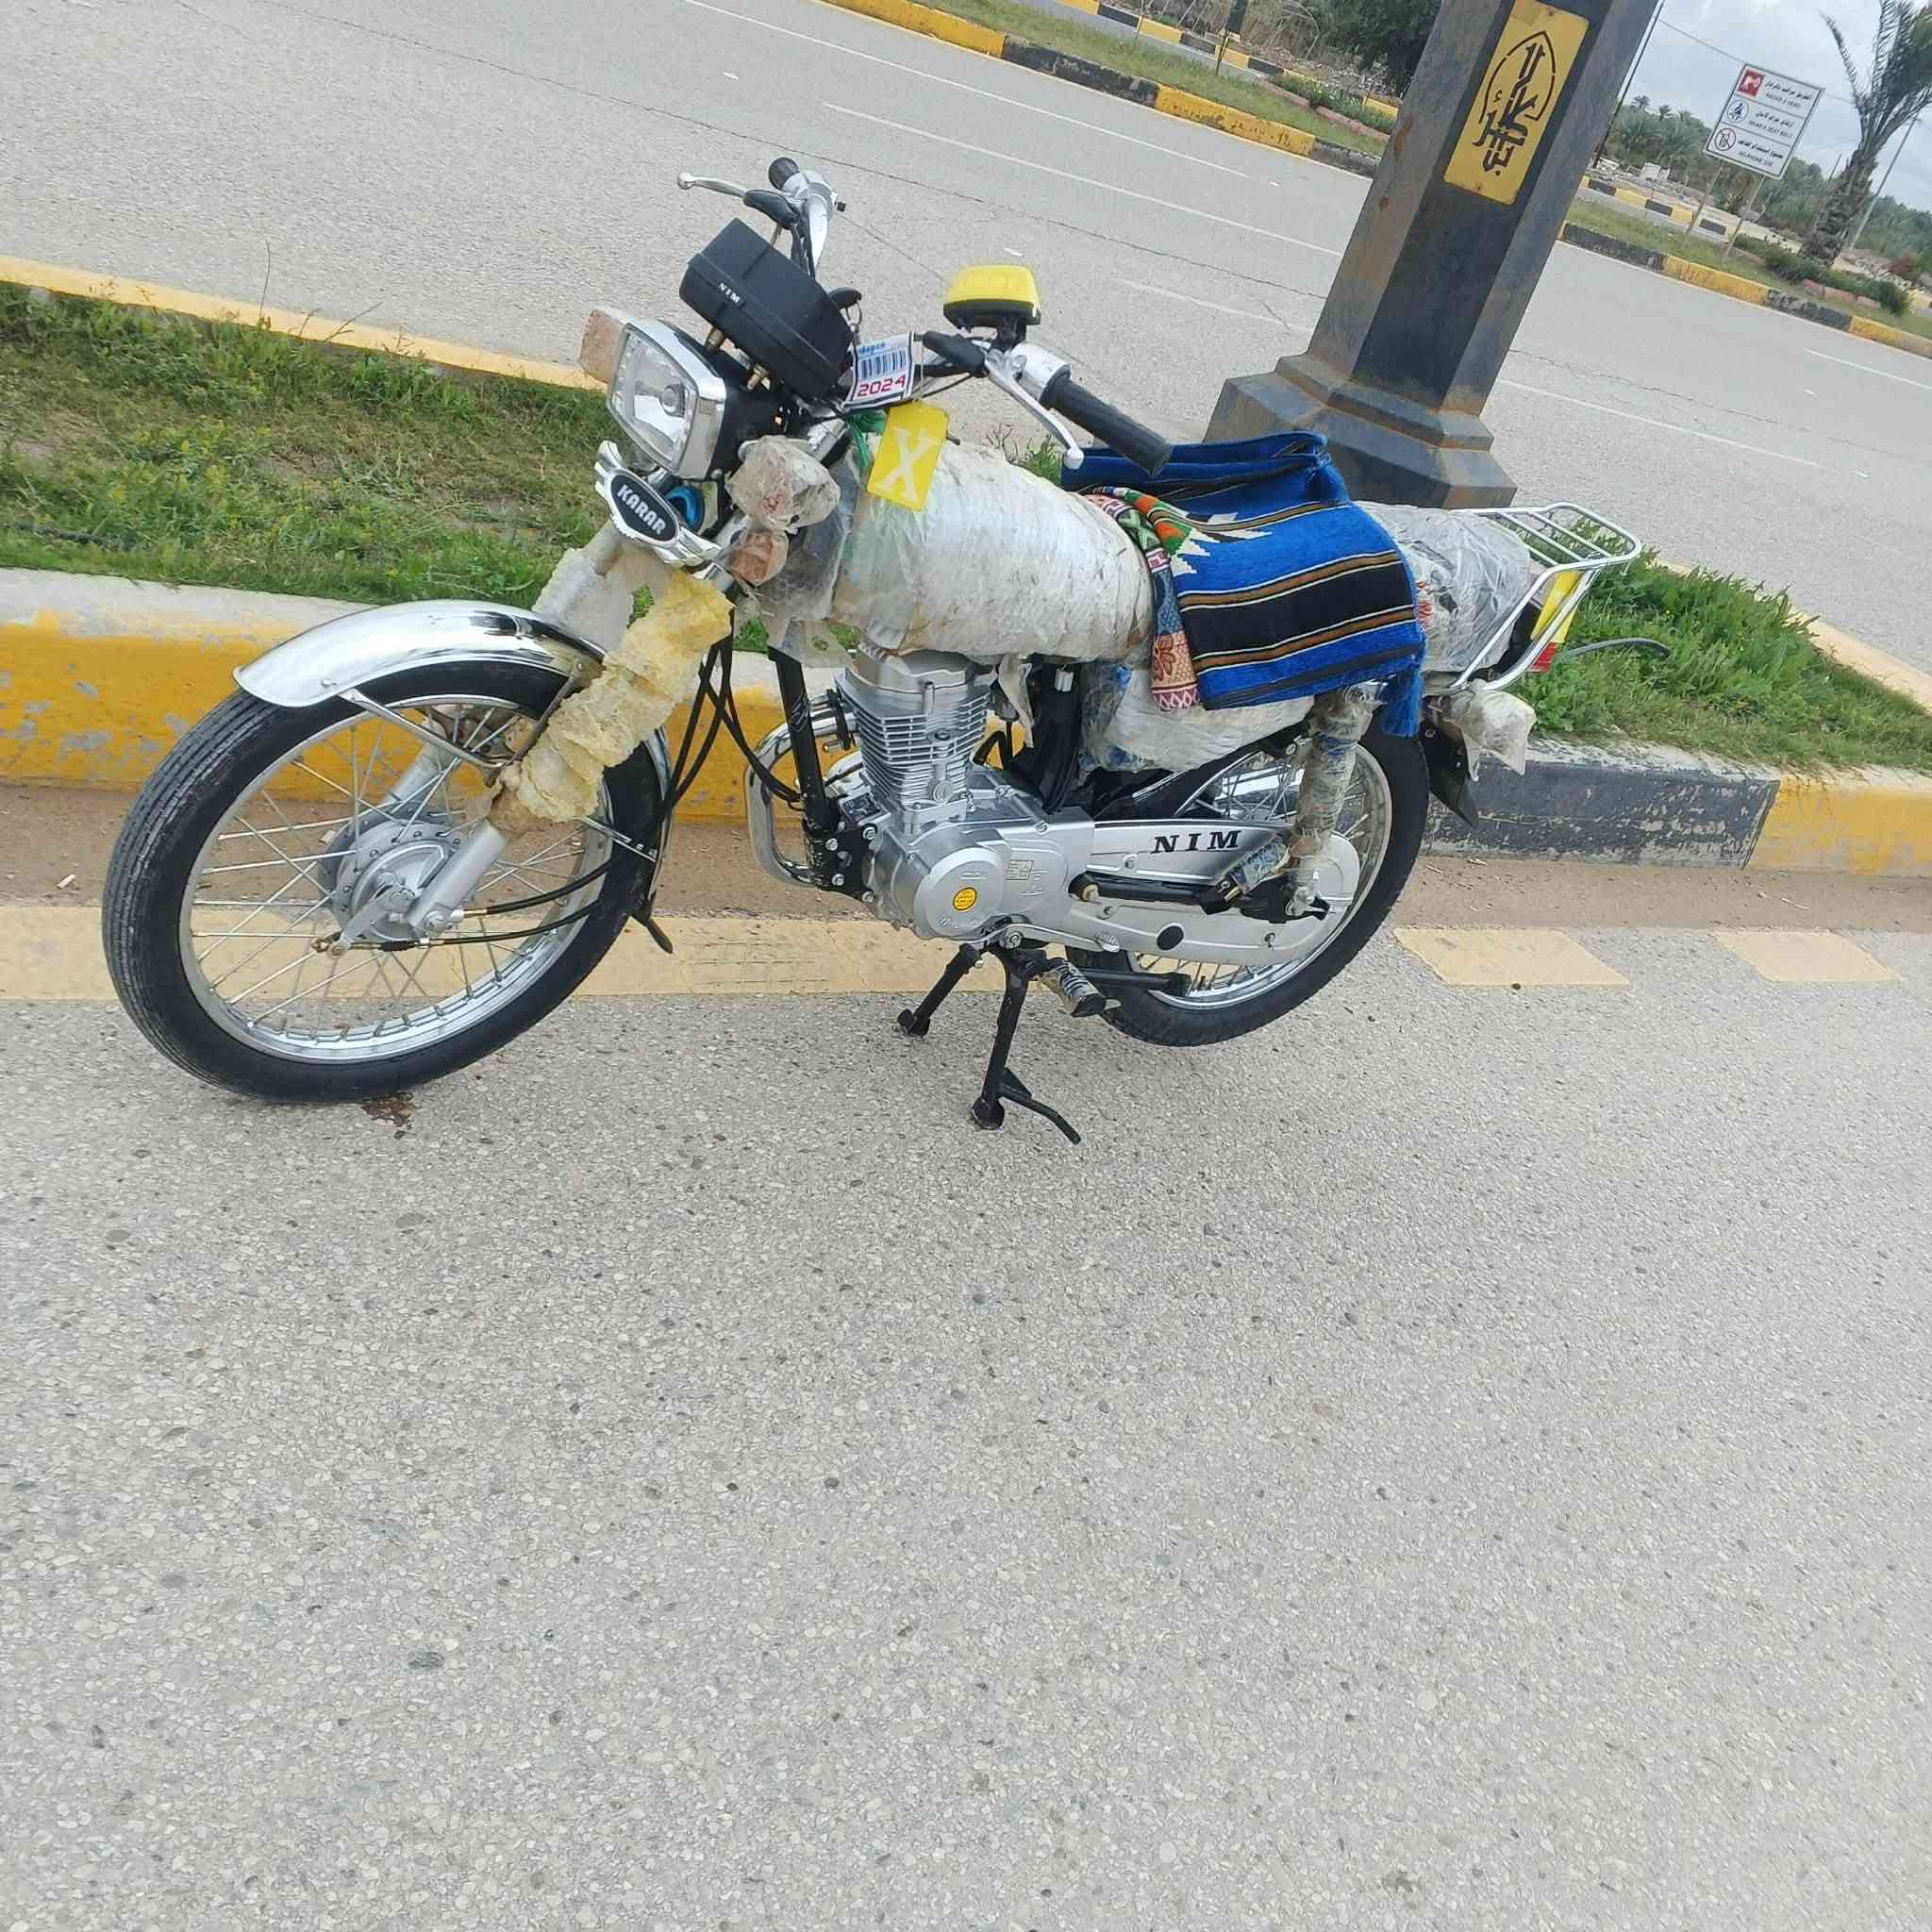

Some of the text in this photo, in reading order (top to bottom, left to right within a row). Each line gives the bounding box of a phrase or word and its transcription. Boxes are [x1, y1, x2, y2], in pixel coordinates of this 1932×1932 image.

[719, 282, 741, 303] NIM
[857, 375, 907, 397] 2024
[883, 425, 937, 502] X
[617, 484, 666, 535] KARAR
[1150, 830, 1241, 854] NIM
